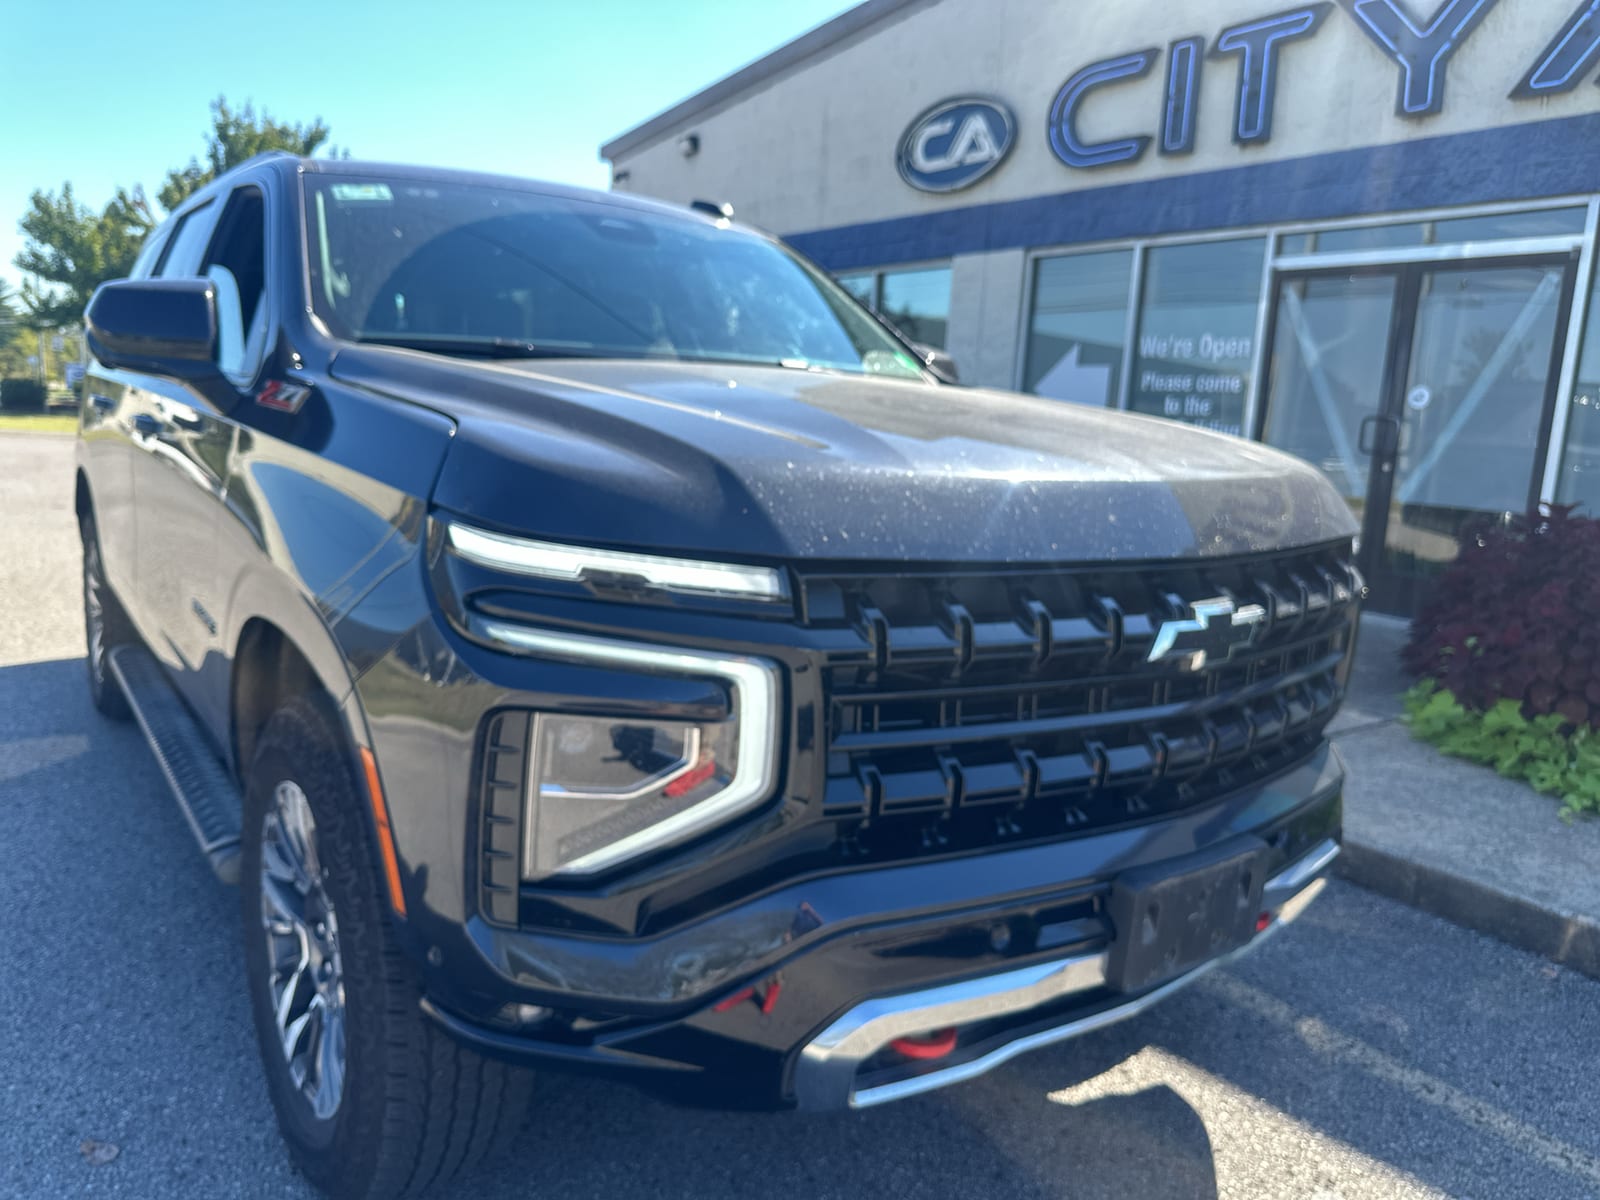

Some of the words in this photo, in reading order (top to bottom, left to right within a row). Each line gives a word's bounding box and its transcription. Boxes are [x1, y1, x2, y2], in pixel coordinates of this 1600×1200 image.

[912, 112, 1000, 173] CA
[1140, 335, 1194, 358] We're
[1199, 333, 1251, 363] Open
[1141, 371, 1194, 392] Please
[1195, 374, 1242, 393] come
[1163, 395, 1181, 415] to
[1184, 394, 1212, 416] the
